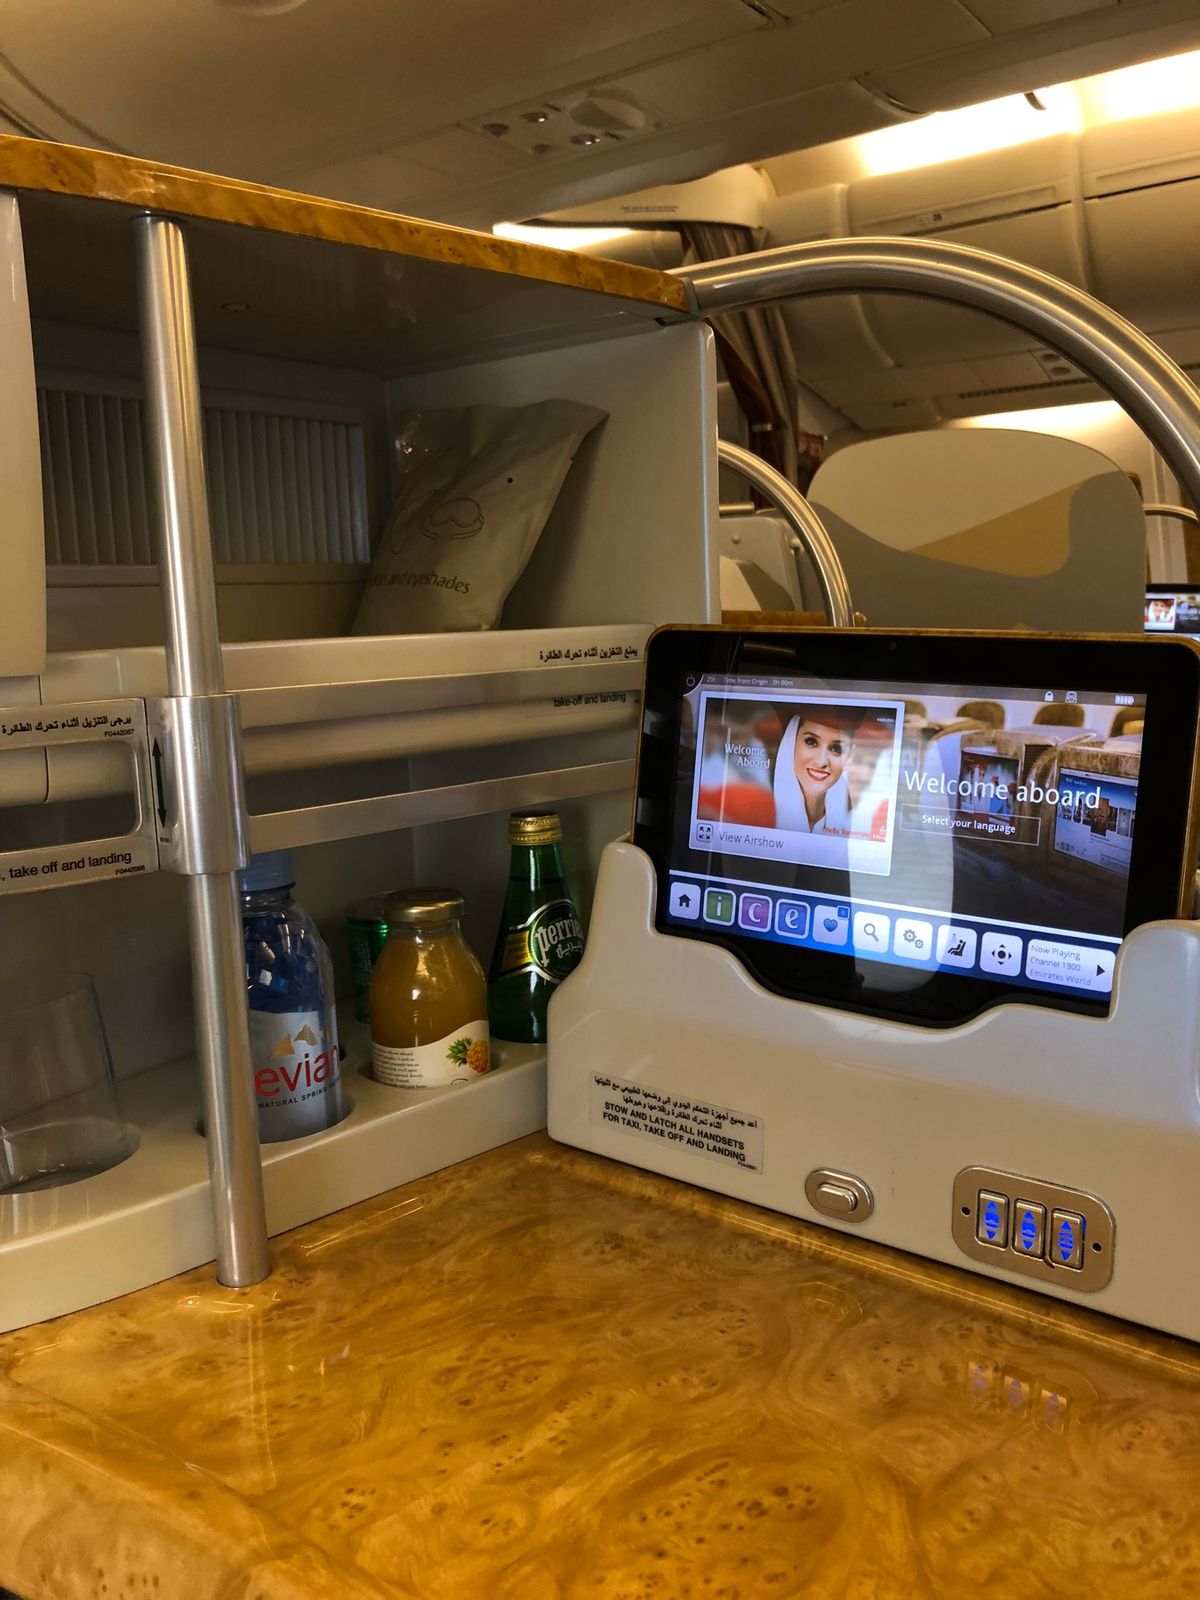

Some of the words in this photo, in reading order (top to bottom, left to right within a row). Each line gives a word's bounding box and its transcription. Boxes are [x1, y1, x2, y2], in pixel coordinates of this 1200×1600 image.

[540, 650, 562, 662] الطائرة
[564, 649, 582, 660] تحرك
[600, 646, 622, 659] التخزين
[584, 695, 598, 705] and
[600, 693, 626, 704] landing
[35, 721, 59, 733] تحرك
[61, 716, 79, 730] أثناء
[110, 716, 131, 727] يرجى
[2, 723, 32, 736] الطائرة
[724, 743, 765, 756] Welcome
[737, 756, 771, 769] Aboard
[904, 771, 1008, 800] Welcome
[1016, 780, 1101, 809] aboard
[922, 814, 949, 827] Select
[950, 818, 972, 830] your
[973, 820, 1016, 835] language
[719, 831, 742, 844] View
[744, 834, 784, 849] Airshow
[9, 866, 39, 879] take
[42, 861, 58, 875] off
[62, 858, 85, 872] and
[88, 852, 132, 868] landing
[535, 913, 585, 967] perrie
[1031, 945, 1050, 955] Now
[1052, 948, 1081, 961] Playing
[1030, 956, 1060, 968] Channel
[1062, 961, 1081, 971] 1900
[1030, 969, 1063, 981] Emirates
[1066, 975, 1091, 986] World
[258, 1098, 298, 1108] NATURAL
[302, 1087, 328, 1101] SPRING
[604, 1102, 629, 1115] STOW
[630, 1110, 648, 1121] AND
[649, 1115, 677, 1130] LATCH
[679, 1124, 695, 1135] ALL
[697, 1129, 745, 1150] HANDSETS
[603, 1112, 619, 1123] FOR
[621, 1117, 642, 1131] TAXI,
[643, 1124, 666, 1138] TAKE
[667, 1131, 685, 1142] OFF
[686, 1137, 704, 1149] AND
[706, 1143, 746, 1162] LANDING
